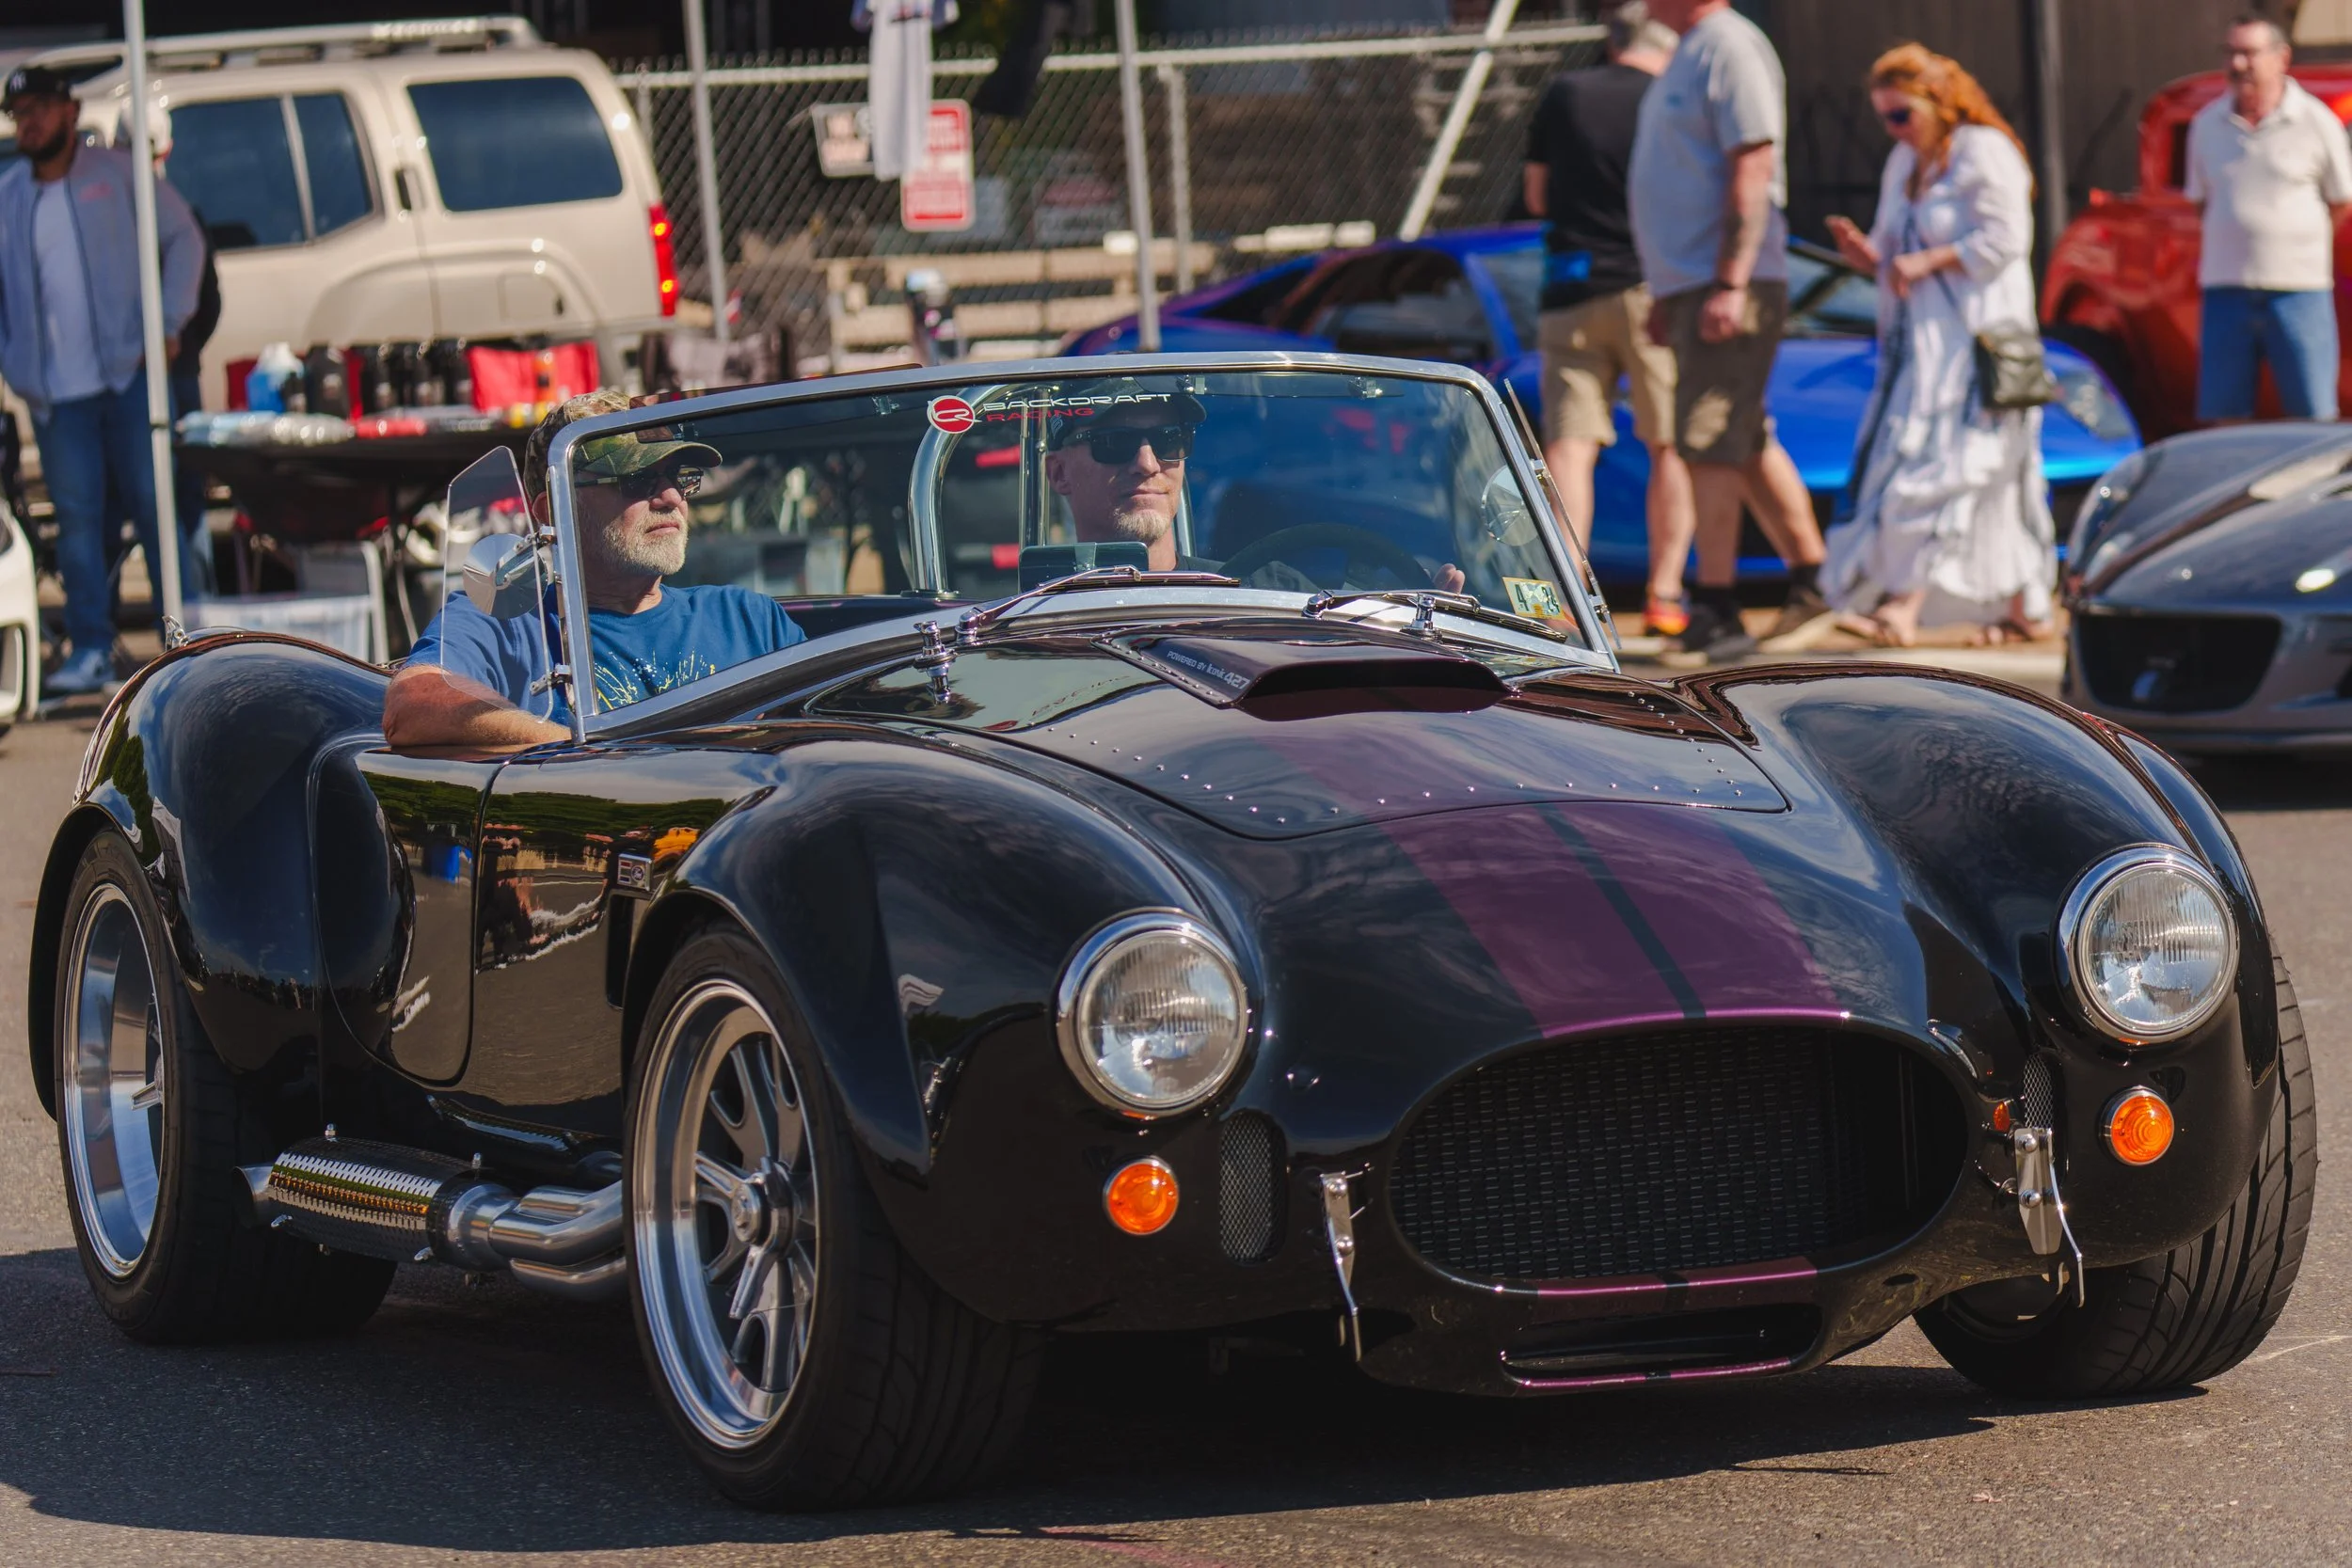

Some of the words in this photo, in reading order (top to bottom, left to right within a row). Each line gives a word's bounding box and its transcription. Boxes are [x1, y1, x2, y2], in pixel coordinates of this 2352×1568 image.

[983, 393, 1171, 412] BACKDRAFT
[987, 407, 1095, 422] RACING
[1167, 651, 1198, 668] POWERED
[1197, 661, 1207, 671] BY
[1223, 672, 1251, 689] 427
